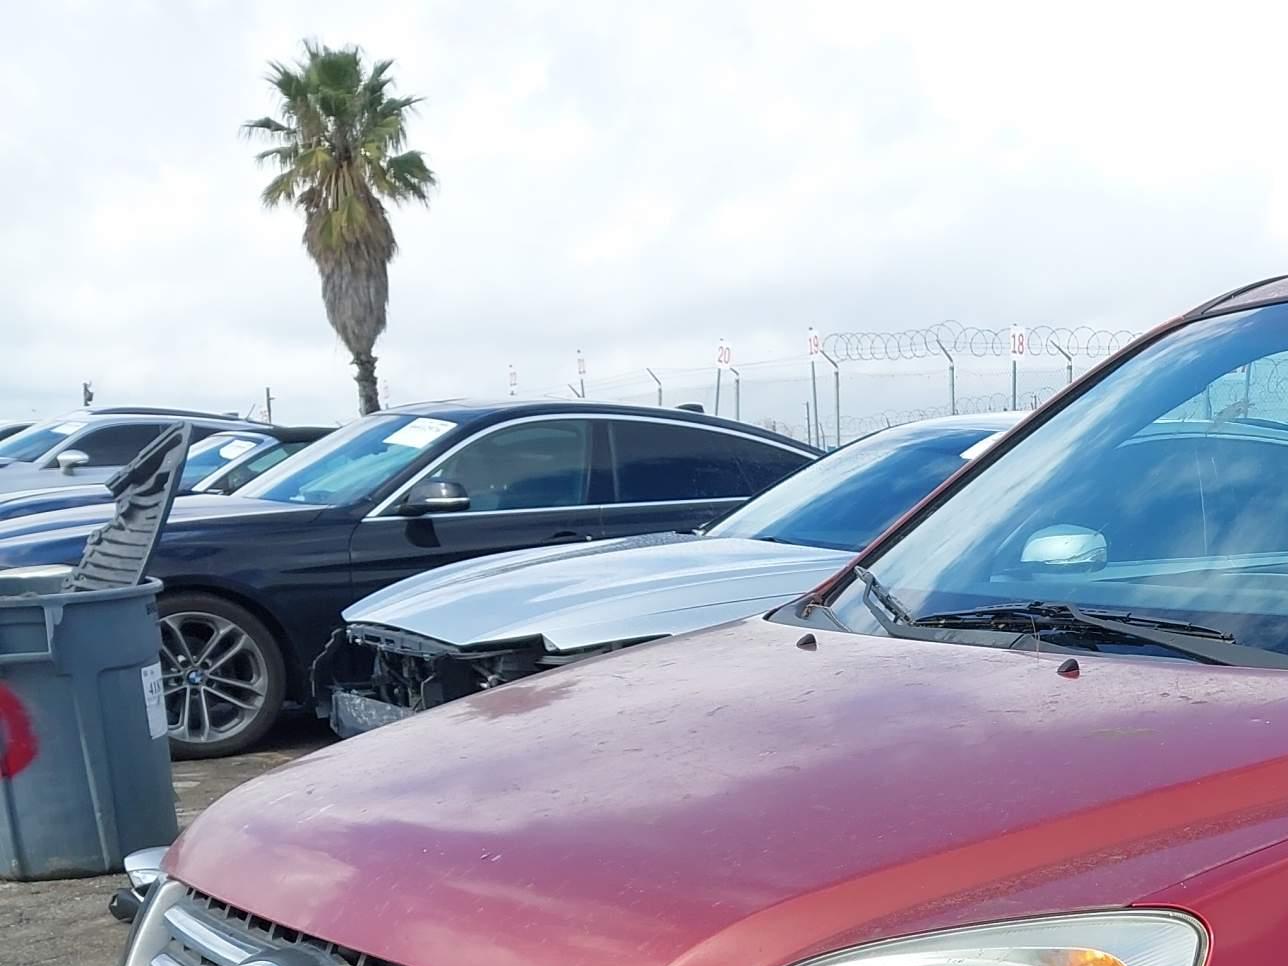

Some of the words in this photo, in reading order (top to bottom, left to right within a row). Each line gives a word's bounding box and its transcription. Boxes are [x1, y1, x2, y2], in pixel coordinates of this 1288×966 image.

[808, 335, 819, 355] 19
[1011, 333, 1025, 355] 18
[717, 345, 731, 365] 20
